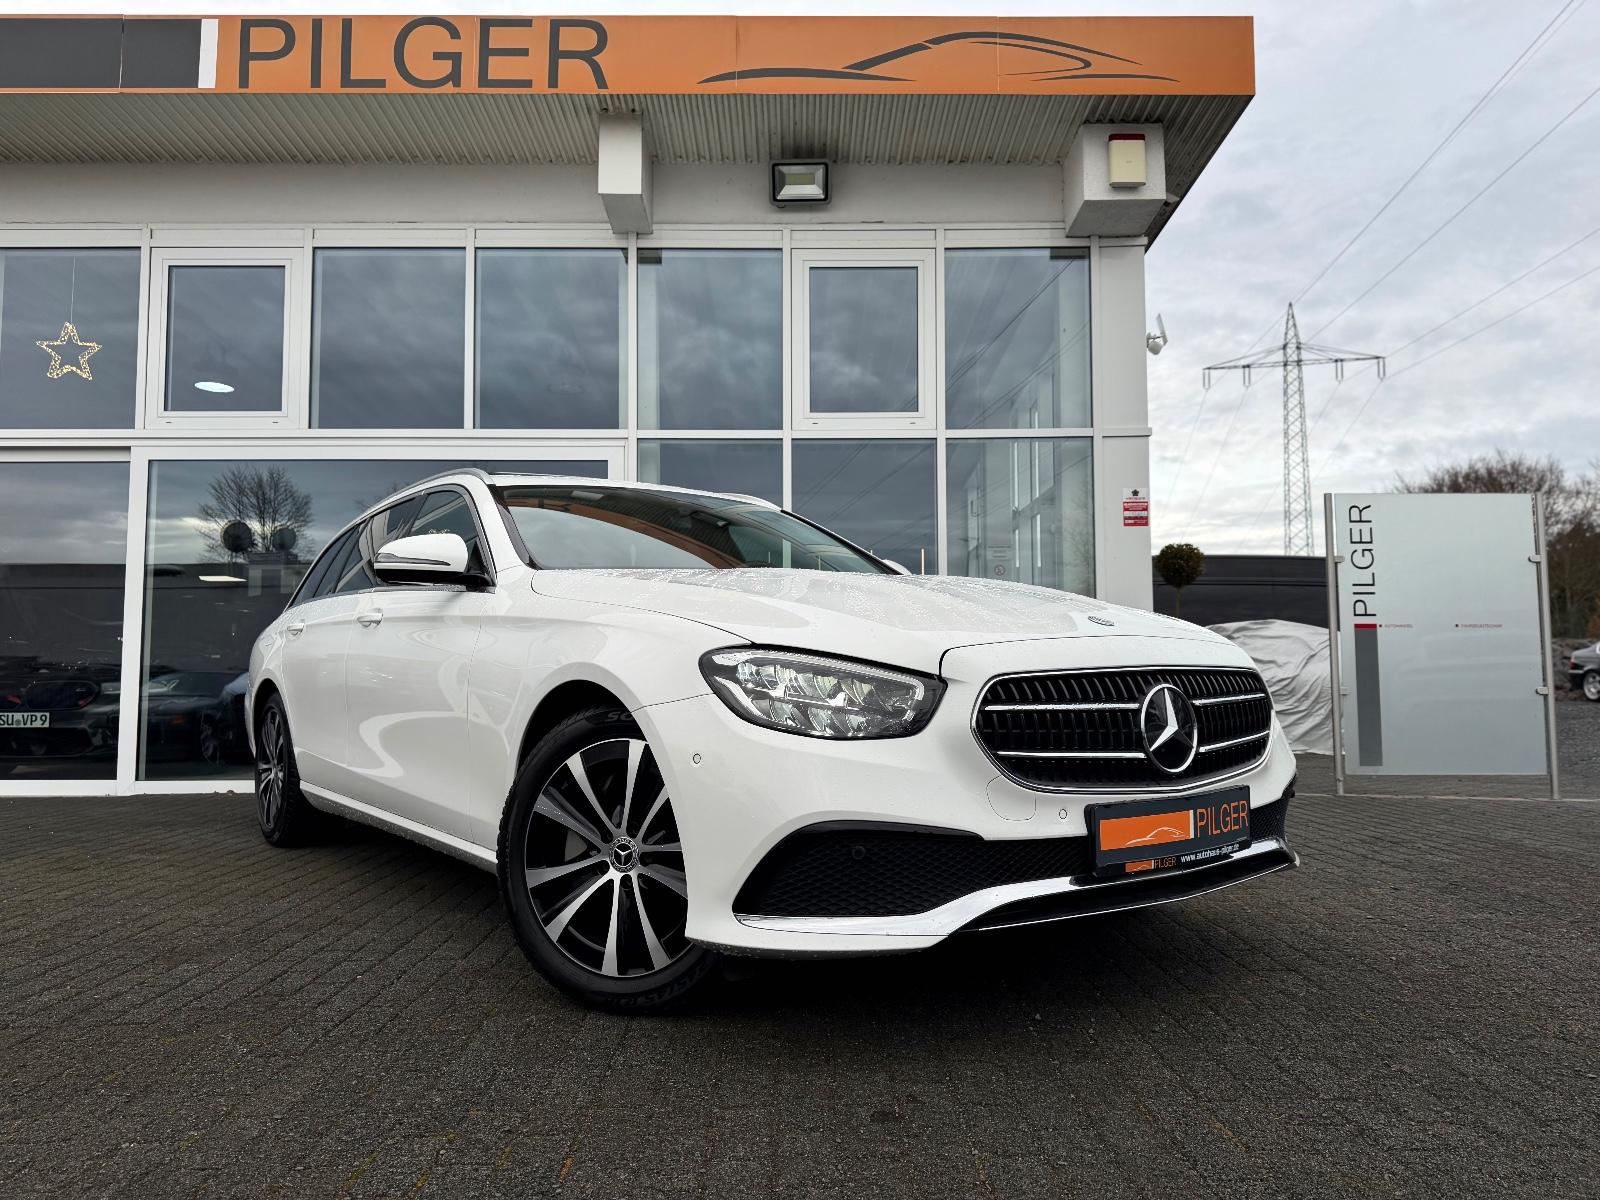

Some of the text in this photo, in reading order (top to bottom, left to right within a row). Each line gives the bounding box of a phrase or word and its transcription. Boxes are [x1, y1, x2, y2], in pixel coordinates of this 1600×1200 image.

[238, 16, 609, 90] PILGER
[1348, 503, 1377, 617] PILGER
[0, 714, 48, 726] SU VP 9
[1197, 800, 1248, 837] PILGER
[1155, 857, 1177, 869] PILGER
[1181, 844, 1239, 862] www.autohaus-pilger.de
